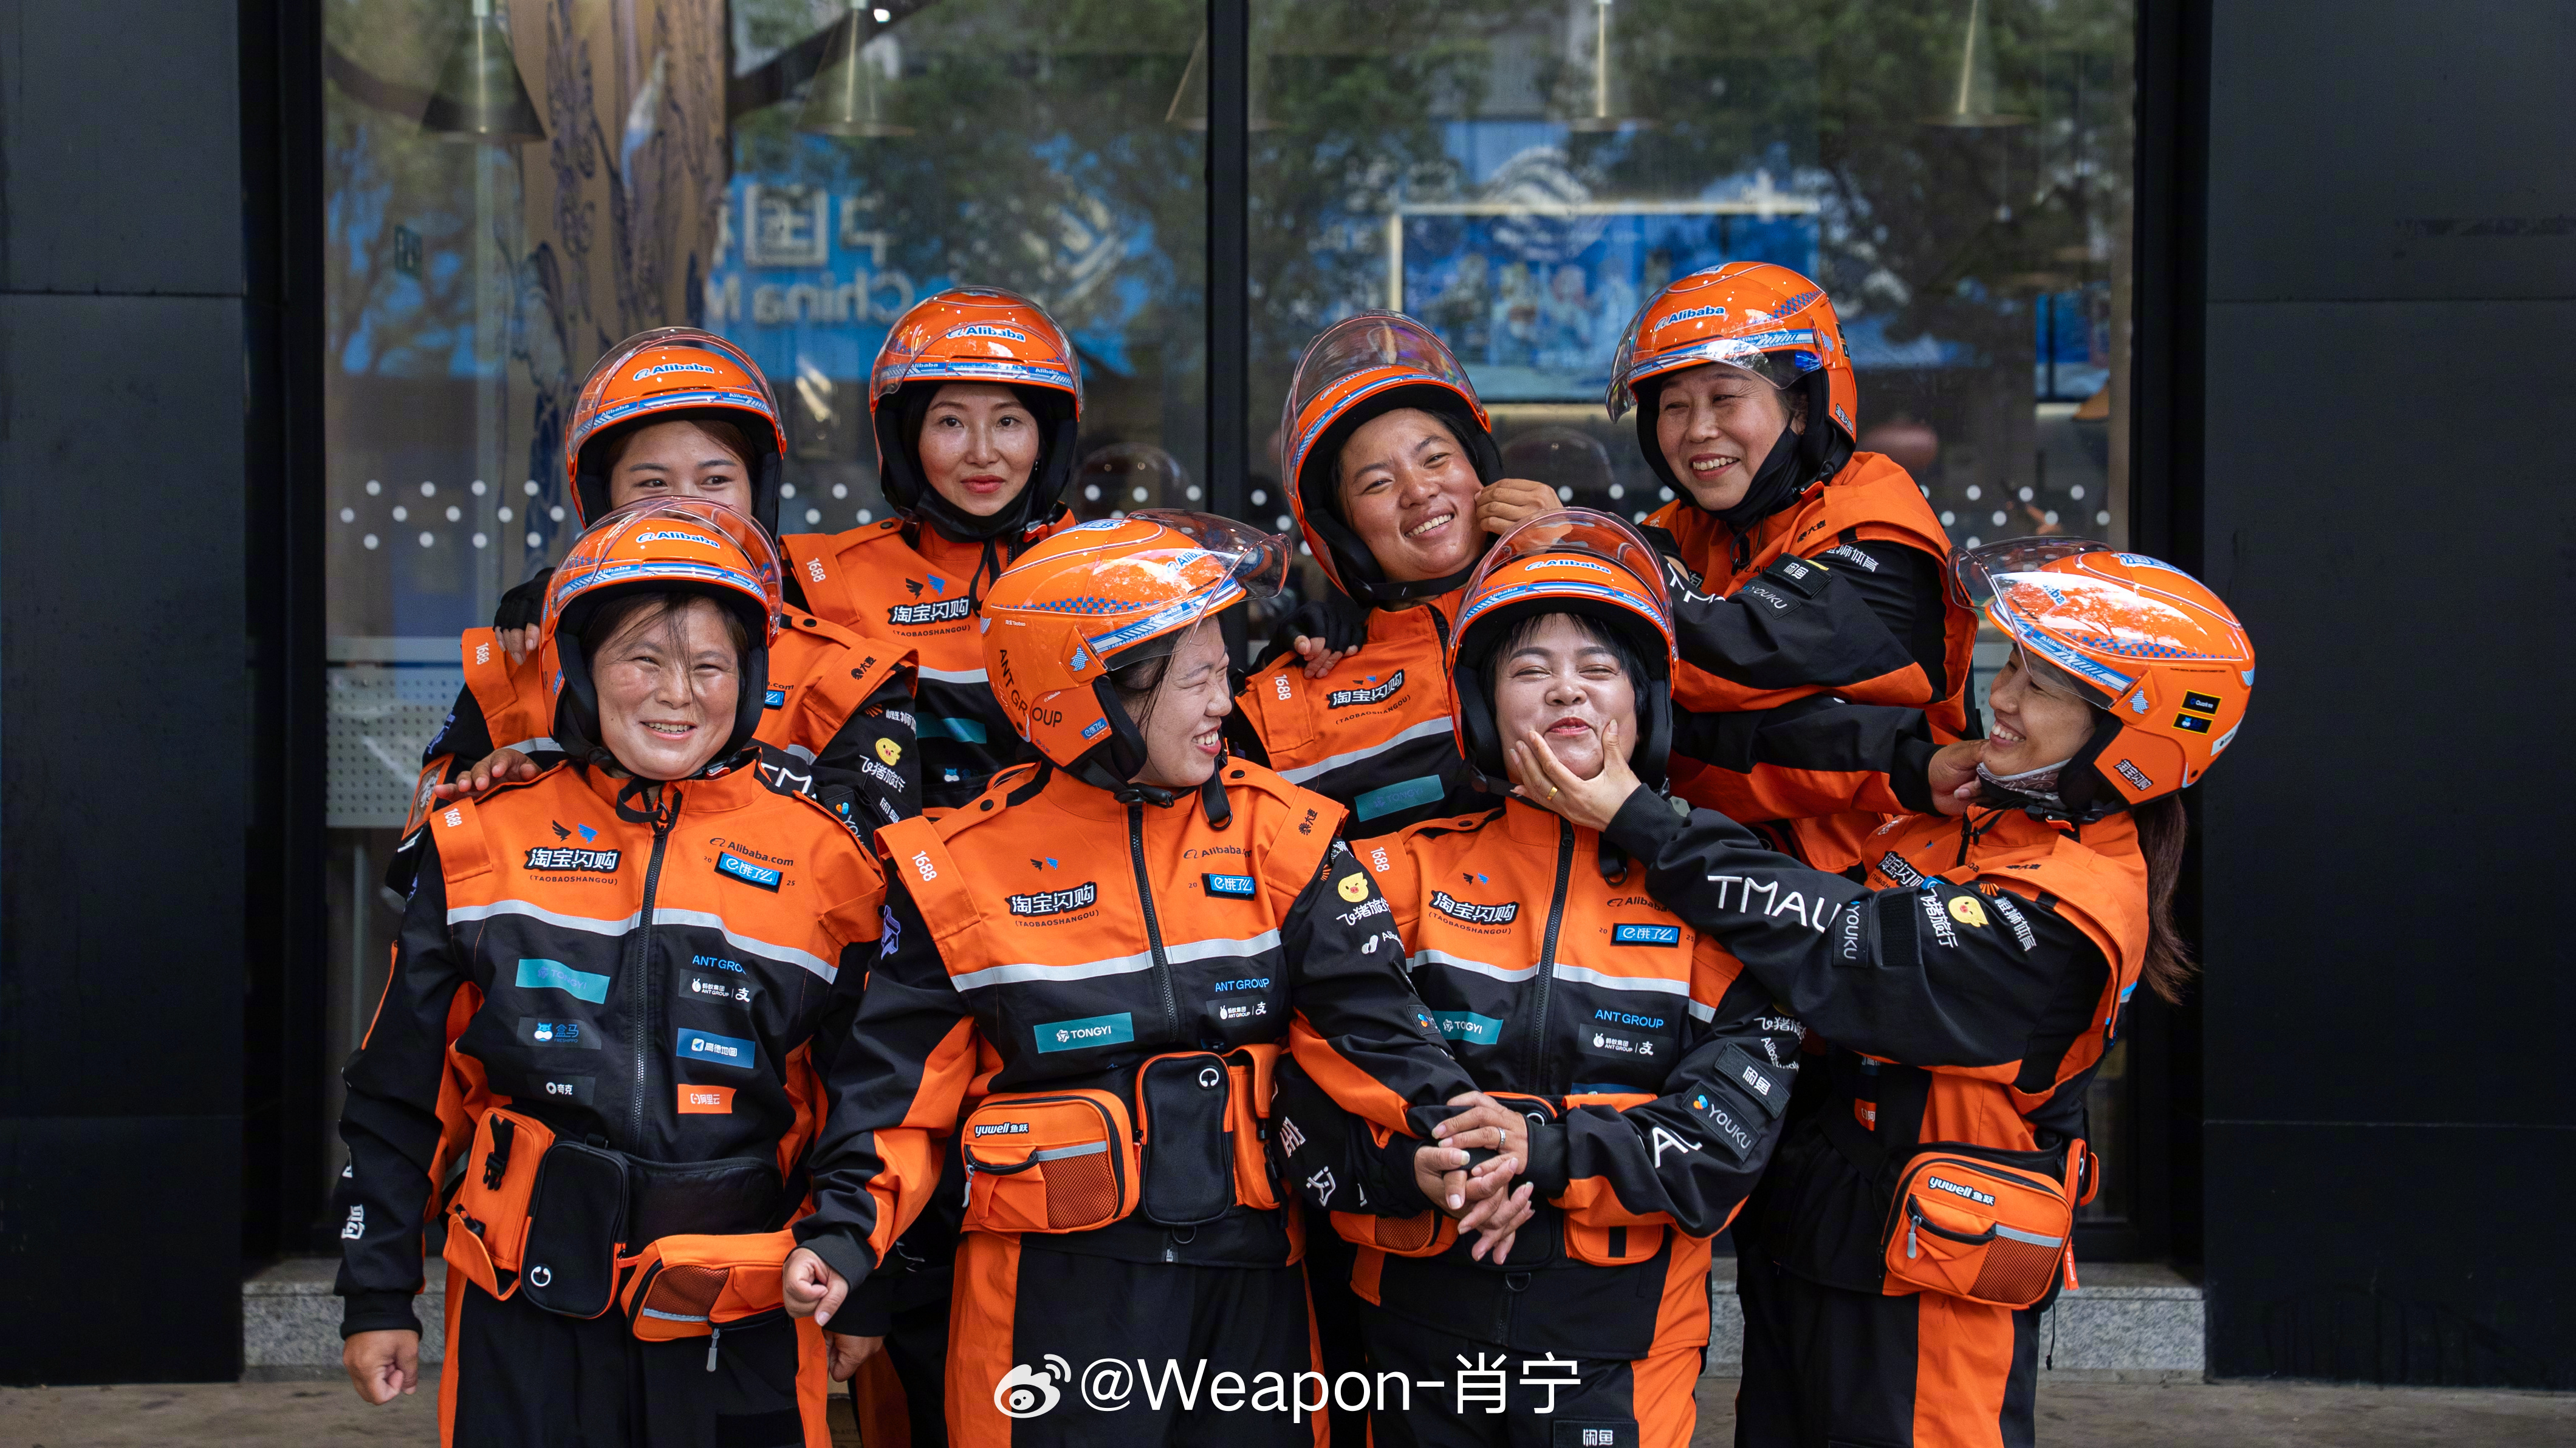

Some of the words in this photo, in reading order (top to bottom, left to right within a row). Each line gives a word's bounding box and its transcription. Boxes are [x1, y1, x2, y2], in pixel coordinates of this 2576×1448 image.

[1668, 307, 1725, 324] Alibaba
[966, 326, 1025, 341] Alibaba
[653, 364, 714, 374] Alibaba
[657, 531, 720, 548] Alibaba
[806, 558, 826, 582] 1688
[1546, 560, 1611, 574] Alibaba
[1783, 561, 1809, 579] 闲鱼
[1750, 585, 1787, 609] YOUKU
[892, 598, 968, 623] 淘宝闪购
[476, 643, 490, 665] 1688
[999, 649, 1014, 687] ANT
[1274, 674, 1292, 700] 1688
[1333, 672, 1402, 705] 淘宝闪购
[2115, 760, 2153, 790] 淘宝闪购
[444, 808, 462, 827] 1688
[528, 849, 617, 869] 淘宝闪购
[728, 841, 793, 866] Alibaba.com
[1371, 847, 1389, 872] 1688
[911, 850, 937, 882] 1688
[1012, 885, 1094, 914] 淘宝闪购
[1433, 892, 1516, 922] 淘宝闪购
[1843, 905, 1860, 960] YOUKU
[1994, 896, 2037, 952] 橙狮体育
[692, 955, 718, 967] ANT
[551, 969, 586, 989] TONGYI
[1215, 980, 1235, 992] ANT
[1236, 978, 1270, 990] GROUP
[1595, 1009, 1621, 1022] ANT
[1622, 1014, 1664, 1029] GROUP
[554, 1024, 579, 1038] 盒马
[1071, 1026, 1111, 1039] TONGYI
[704, 1042, 738, 1057] 高德地图
[557, 1084, 572, 1095] 夸克
[1742, 1065, 1771, 1095] 闲鱼
[700, 1093, 720, 1105] 阿里云
[975, 1122, 1009, 1138] yuwell
[1009, 1123, 1029, 1133] 鱼跃
[1709, 1104, 1752, 1150] YOUKU
[1930, 1177, 1973, 1198] yuwell
[1971, 1191, 1995, 1205] 鱼跃
[1583, 1429, 1613, 1447] 闲鱼
